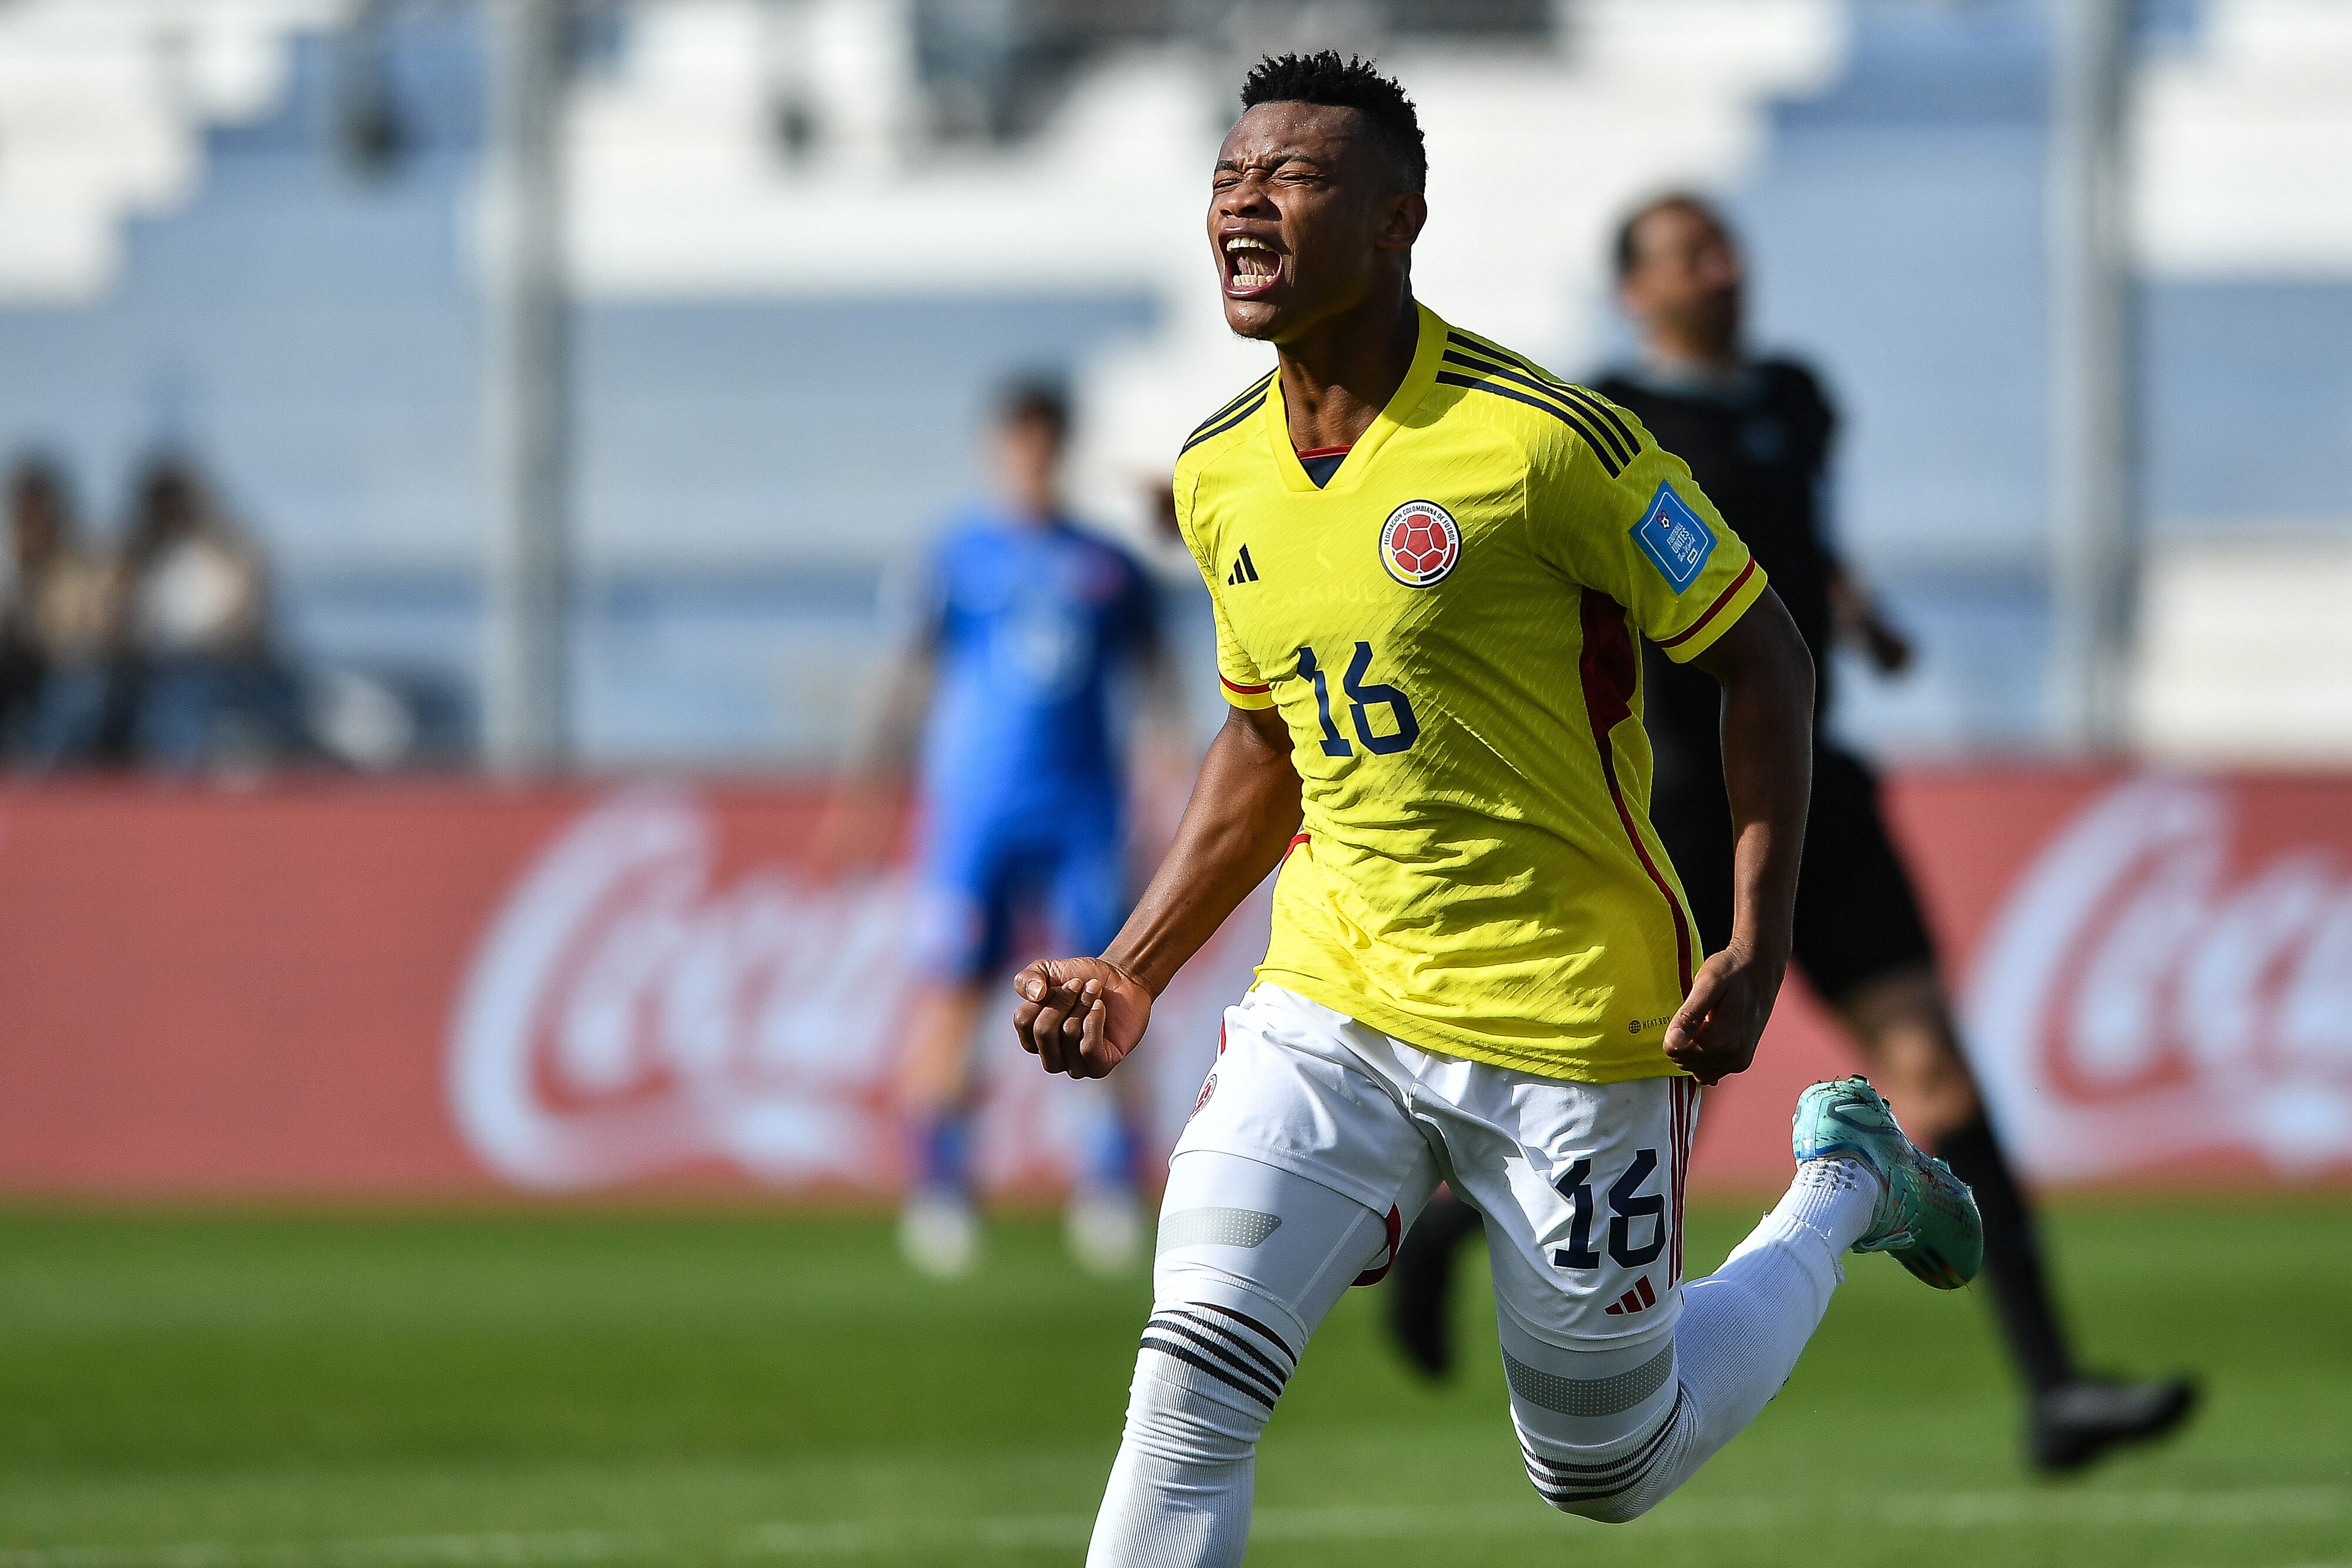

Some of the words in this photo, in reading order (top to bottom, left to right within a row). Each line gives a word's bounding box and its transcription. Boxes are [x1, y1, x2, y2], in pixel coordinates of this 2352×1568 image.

[1402, 505, 1437, 516] COLOMBIANA
[1442, 520, 1455, 542] FUTBOL
[1671, 527, 1689, 553] UNITES
[1297, 641, 1420, 756] 16
[1554, 1148, 1666, 1269] 16
